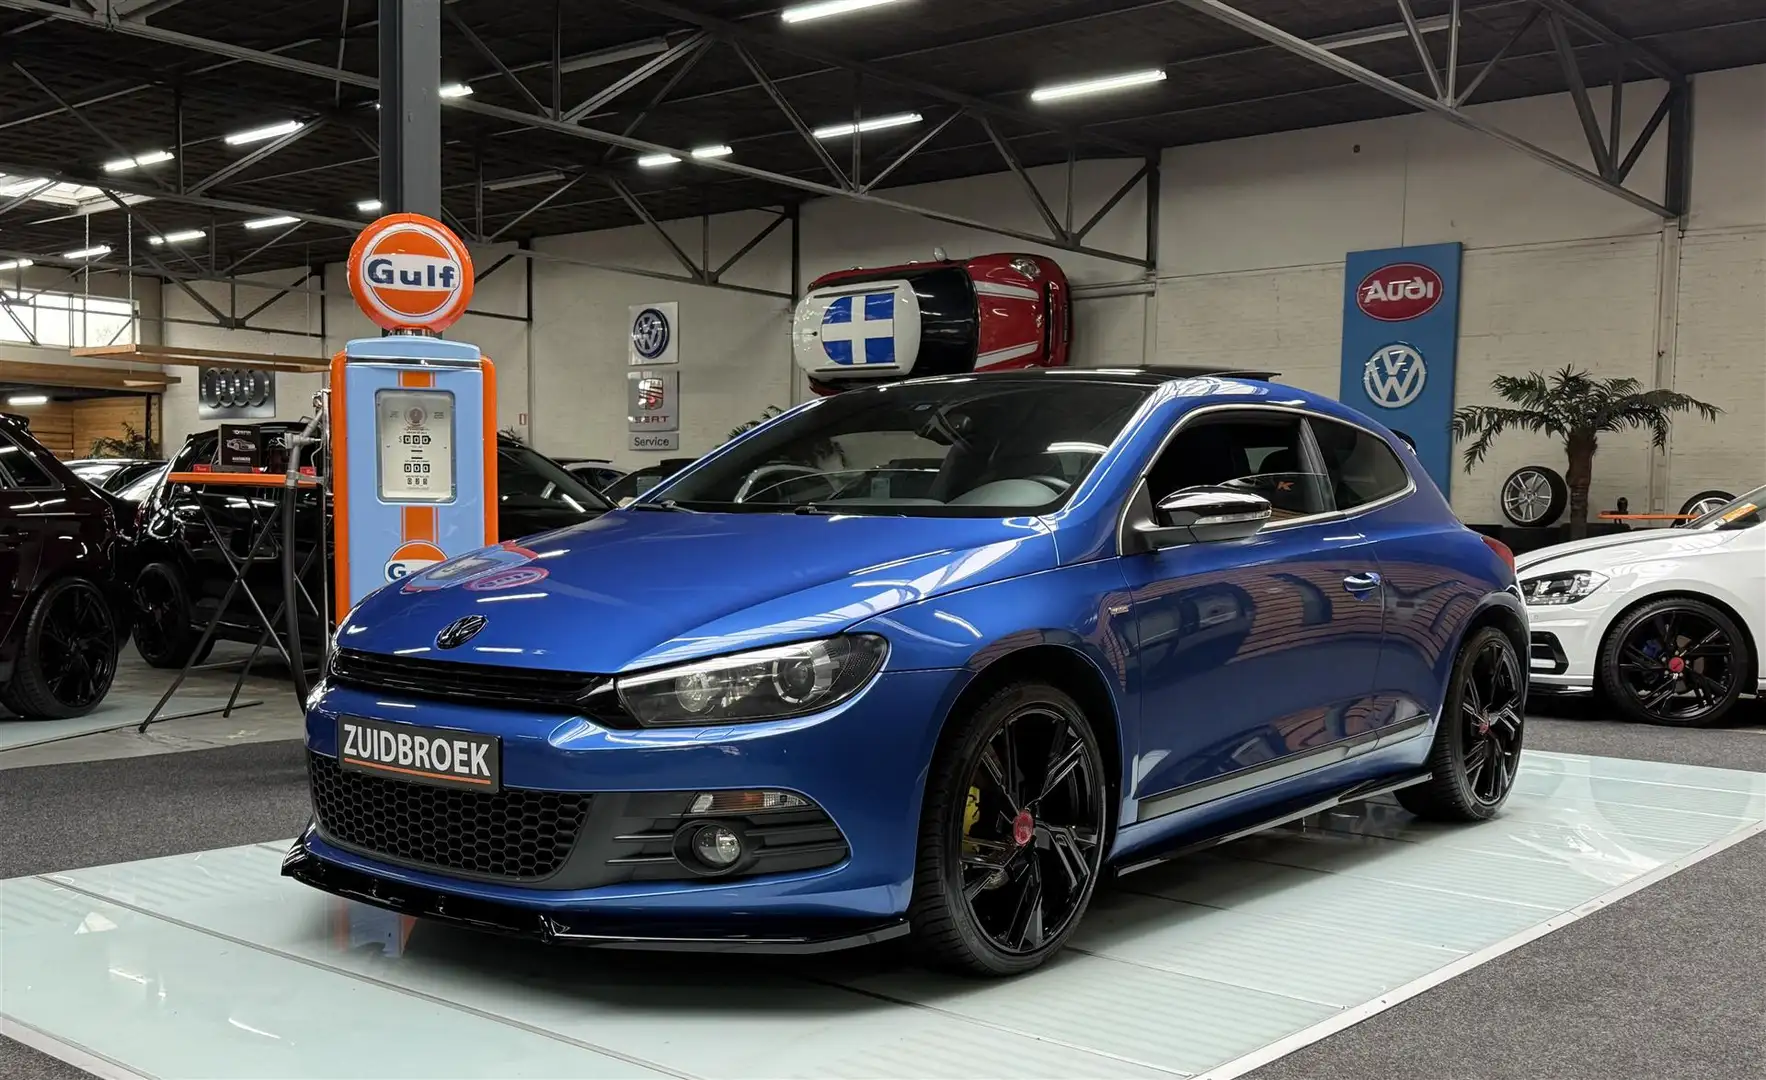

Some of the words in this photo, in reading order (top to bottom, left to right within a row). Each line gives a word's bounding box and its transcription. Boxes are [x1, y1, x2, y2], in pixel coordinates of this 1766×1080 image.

[367, 258, 455, 288] Gulf
[1365, 344, 1427, 410] VW
[634, 415, 669, 424] SEAT
[633, 437, 670, 448] Service
[343, 723, 491, 777] ZUIDBROEK
